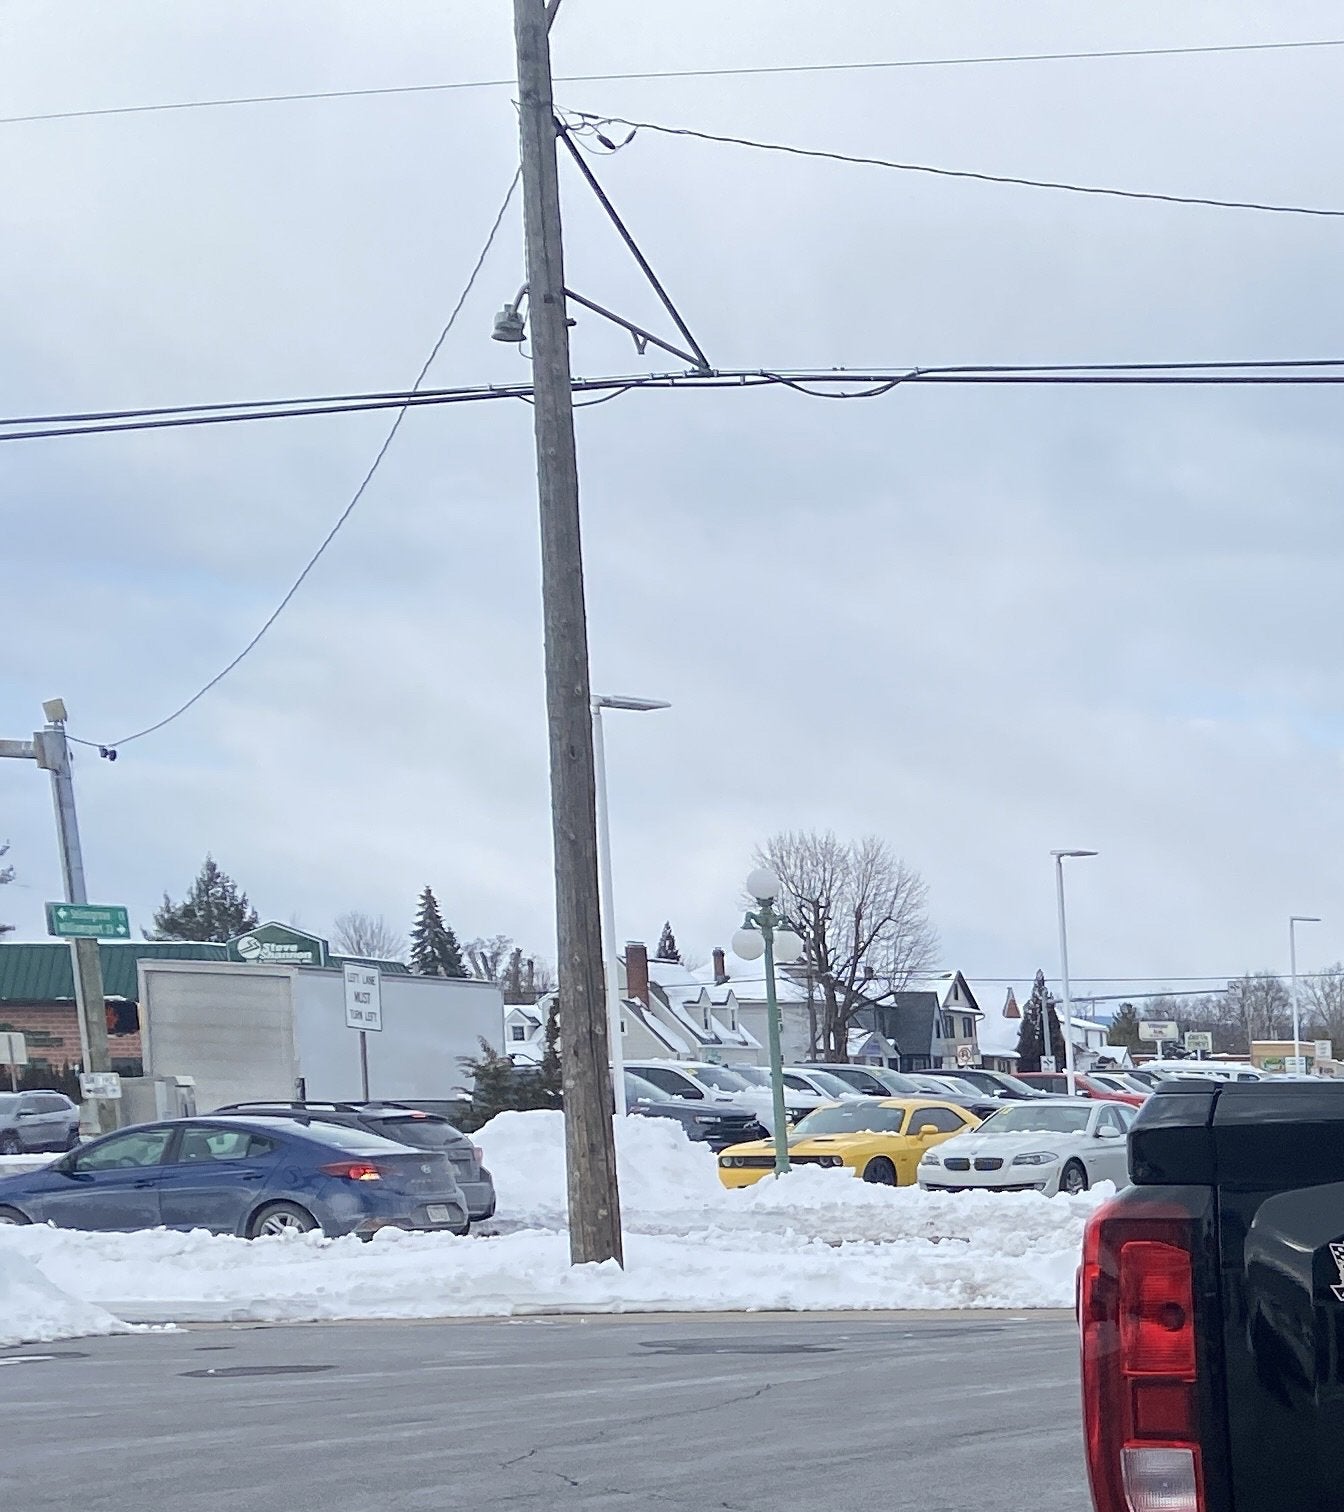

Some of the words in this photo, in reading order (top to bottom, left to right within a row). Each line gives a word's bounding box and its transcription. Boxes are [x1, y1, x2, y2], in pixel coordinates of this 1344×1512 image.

[262, 943, 298, 952] Steve
[262, 949, 313, 960] Shannon
[354, 991, 371, 1004] MUST
